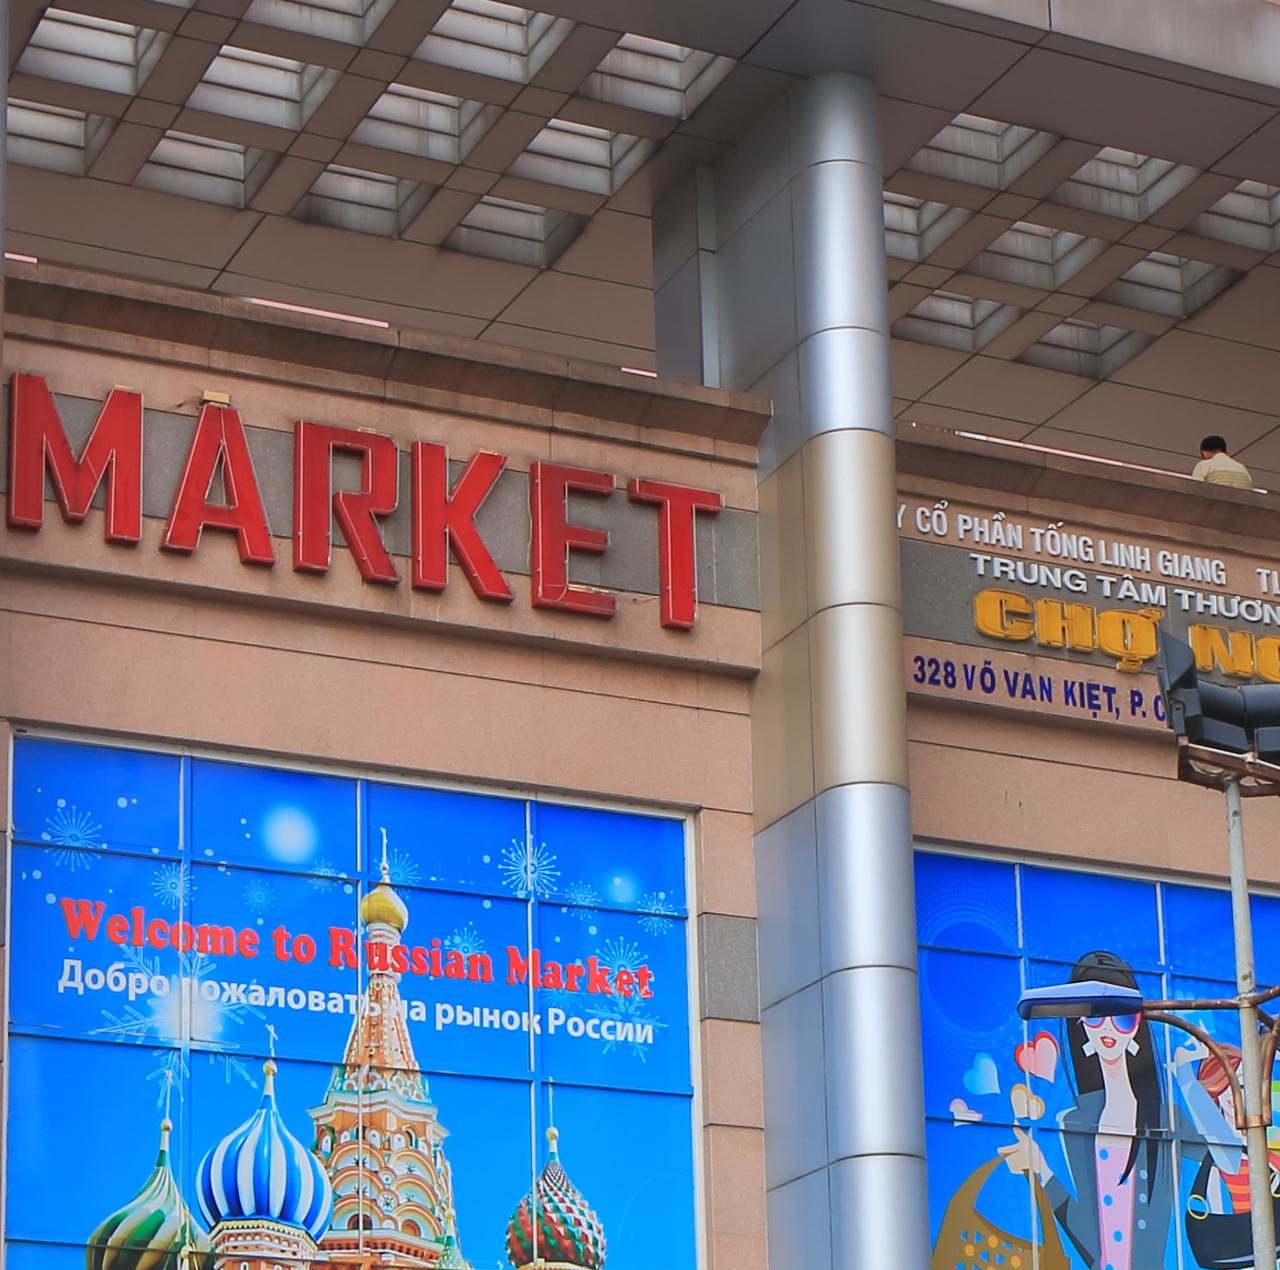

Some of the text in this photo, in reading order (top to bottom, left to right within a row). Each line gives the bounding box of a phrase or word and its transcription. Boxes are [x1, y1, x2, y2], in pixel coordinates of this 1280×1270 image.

[7, 370, 723, 630] MARKET
[916, 500, 948, 537] CỔ
[956, 511, 1023, 550] PHẦN
[1099, 539, 1151, 572] LINH
[1157, 549, 1227, 586] GIANG
[970, 552, 1088, 593] TRUNG
[1095, 574, 1167, 607] TÂM
[975, 588, 1164, 673] CHỢ
[912, 654, 956, 689] 328
[962, 660, 997, 694] VÕ
[1130, 688, 1147, 718] P.
[59, 898, 654, 1000] Welcome to Russian Market
[57, 957, 171, 1002] Добро
[434, 1002, 542, 1035] рынок
[547, 1006, 655, 1045] России
